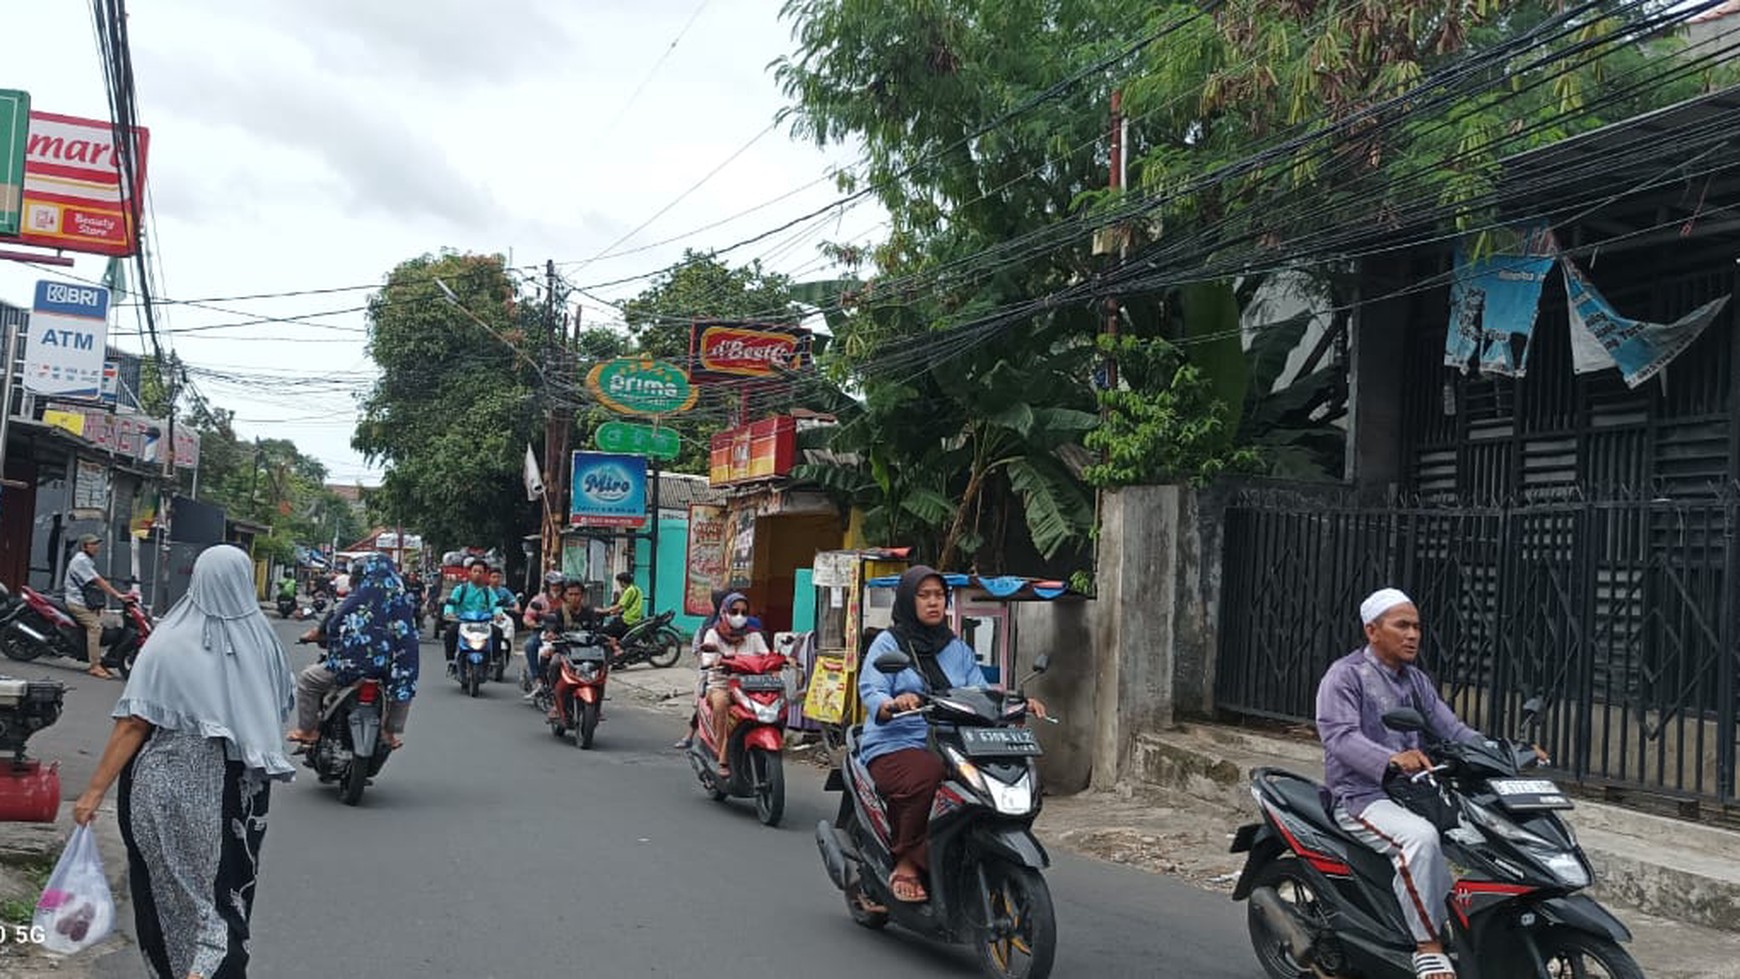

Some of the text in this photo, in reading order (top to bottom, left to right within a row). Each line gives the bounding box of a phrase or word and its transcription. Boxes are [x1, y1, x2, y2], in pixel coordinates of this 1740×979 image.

[75, 213, 114, 230] Beauty
[79, 224, 107, 236] Store
[68, 288, 98, 306] BRI
[41, 329, 94, 351] ATM
